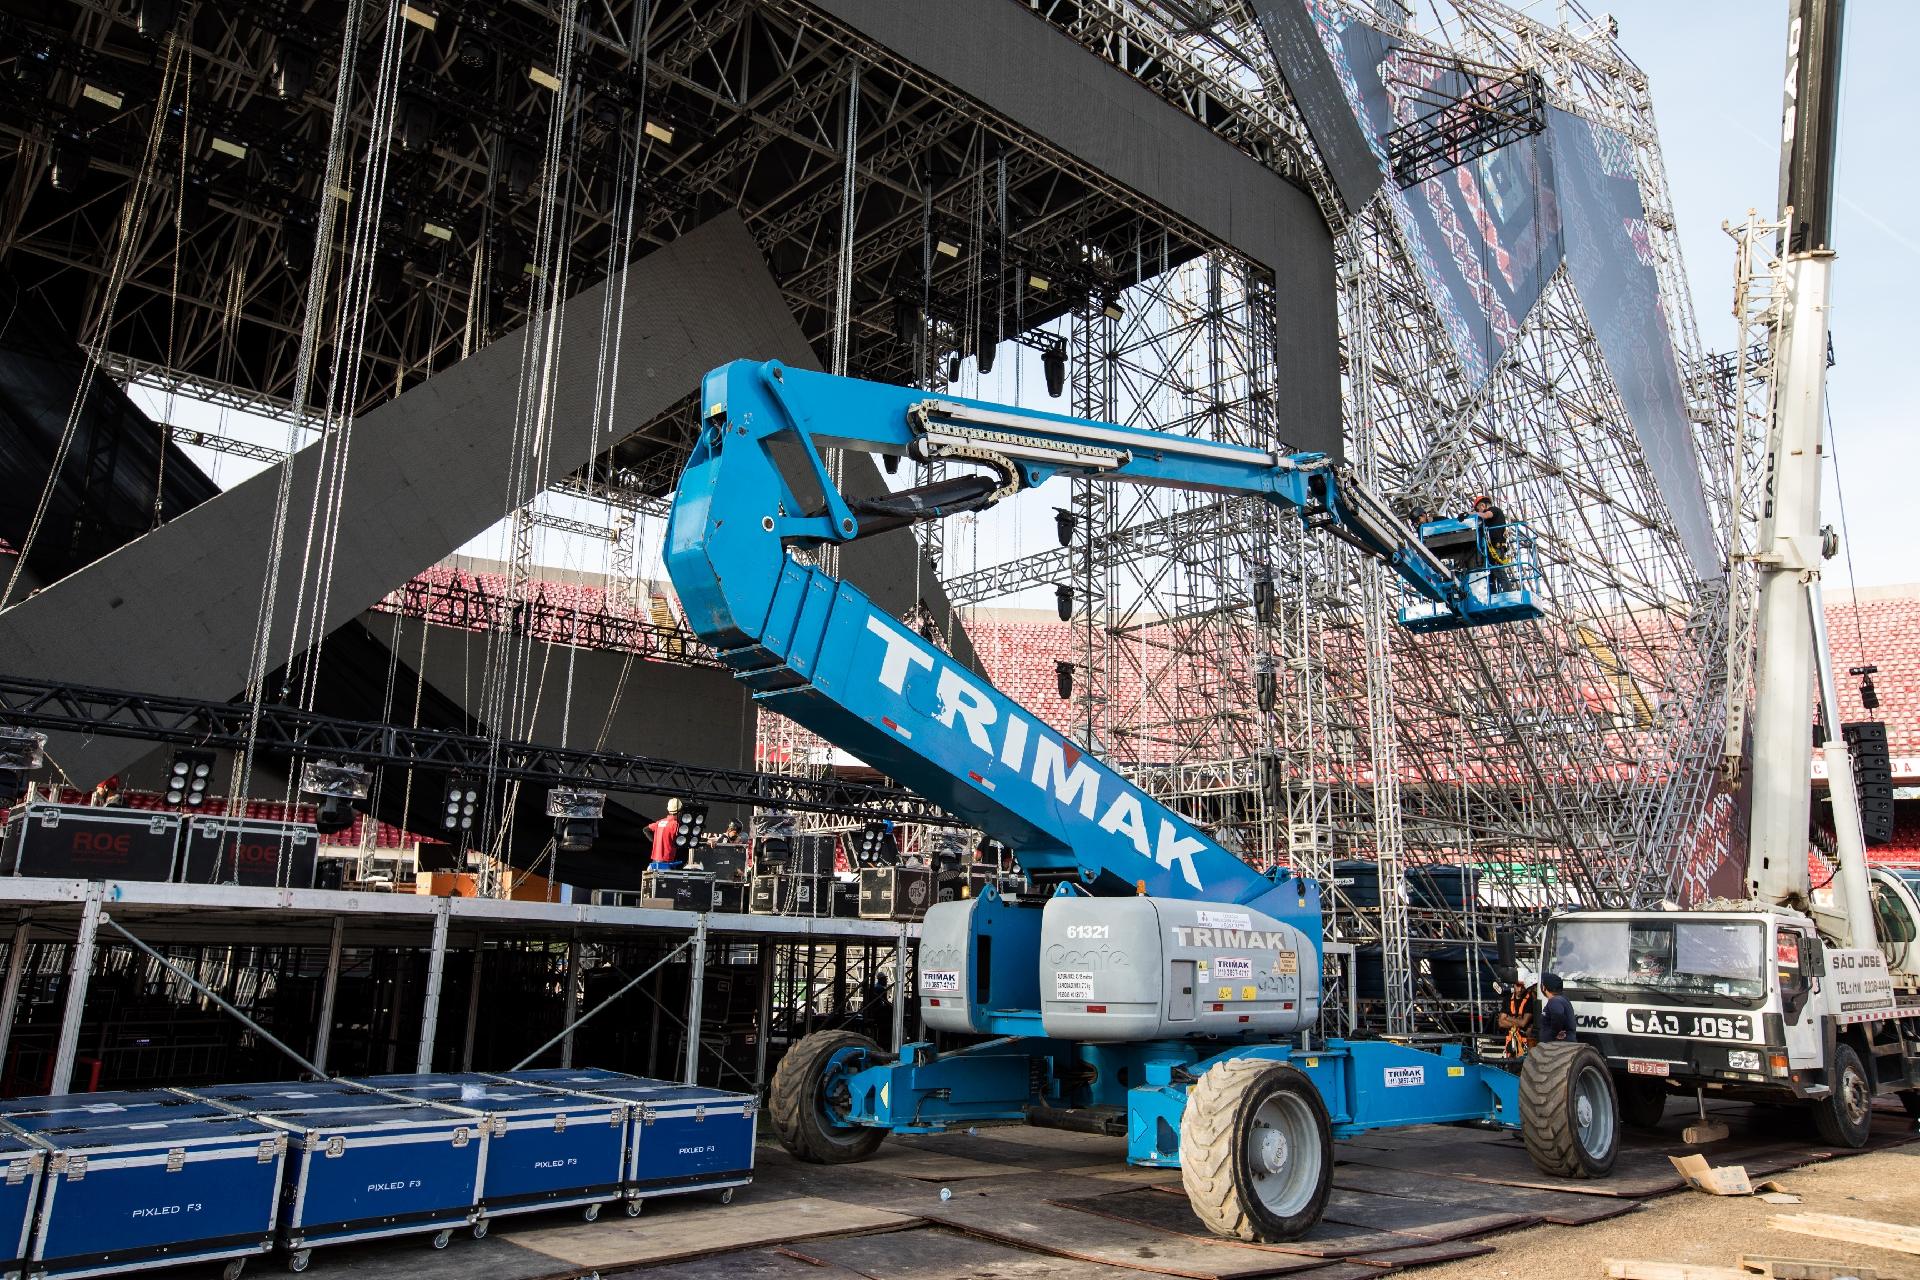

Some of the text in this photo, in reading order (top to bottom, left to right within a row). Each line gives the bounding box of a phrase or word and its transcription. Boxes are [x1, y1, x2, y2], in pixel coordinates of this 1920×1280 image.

[866, 615, 1208, 892] TRIMAK
[72, 831, 131, 855] ROE
[1066, 925, 1109, 939] 61321
[1172, 927, 1286, 950] TRIMAK
[1217, 960, 1249, 969] TRIMAK
[923, 973, 955, 981] TRIMAK
[1575, 1015, 1608, 1028] CMG
[1388, 1069, 1421, 1077] TRIMAK
[678, 1146, 704, 1154] PIXLED
[534, 1160, 564, 1168] PIXLED
[367, 1181, 405, 1192] PIXLED
[132, 1203, 202, 1218] PIXLED F3
